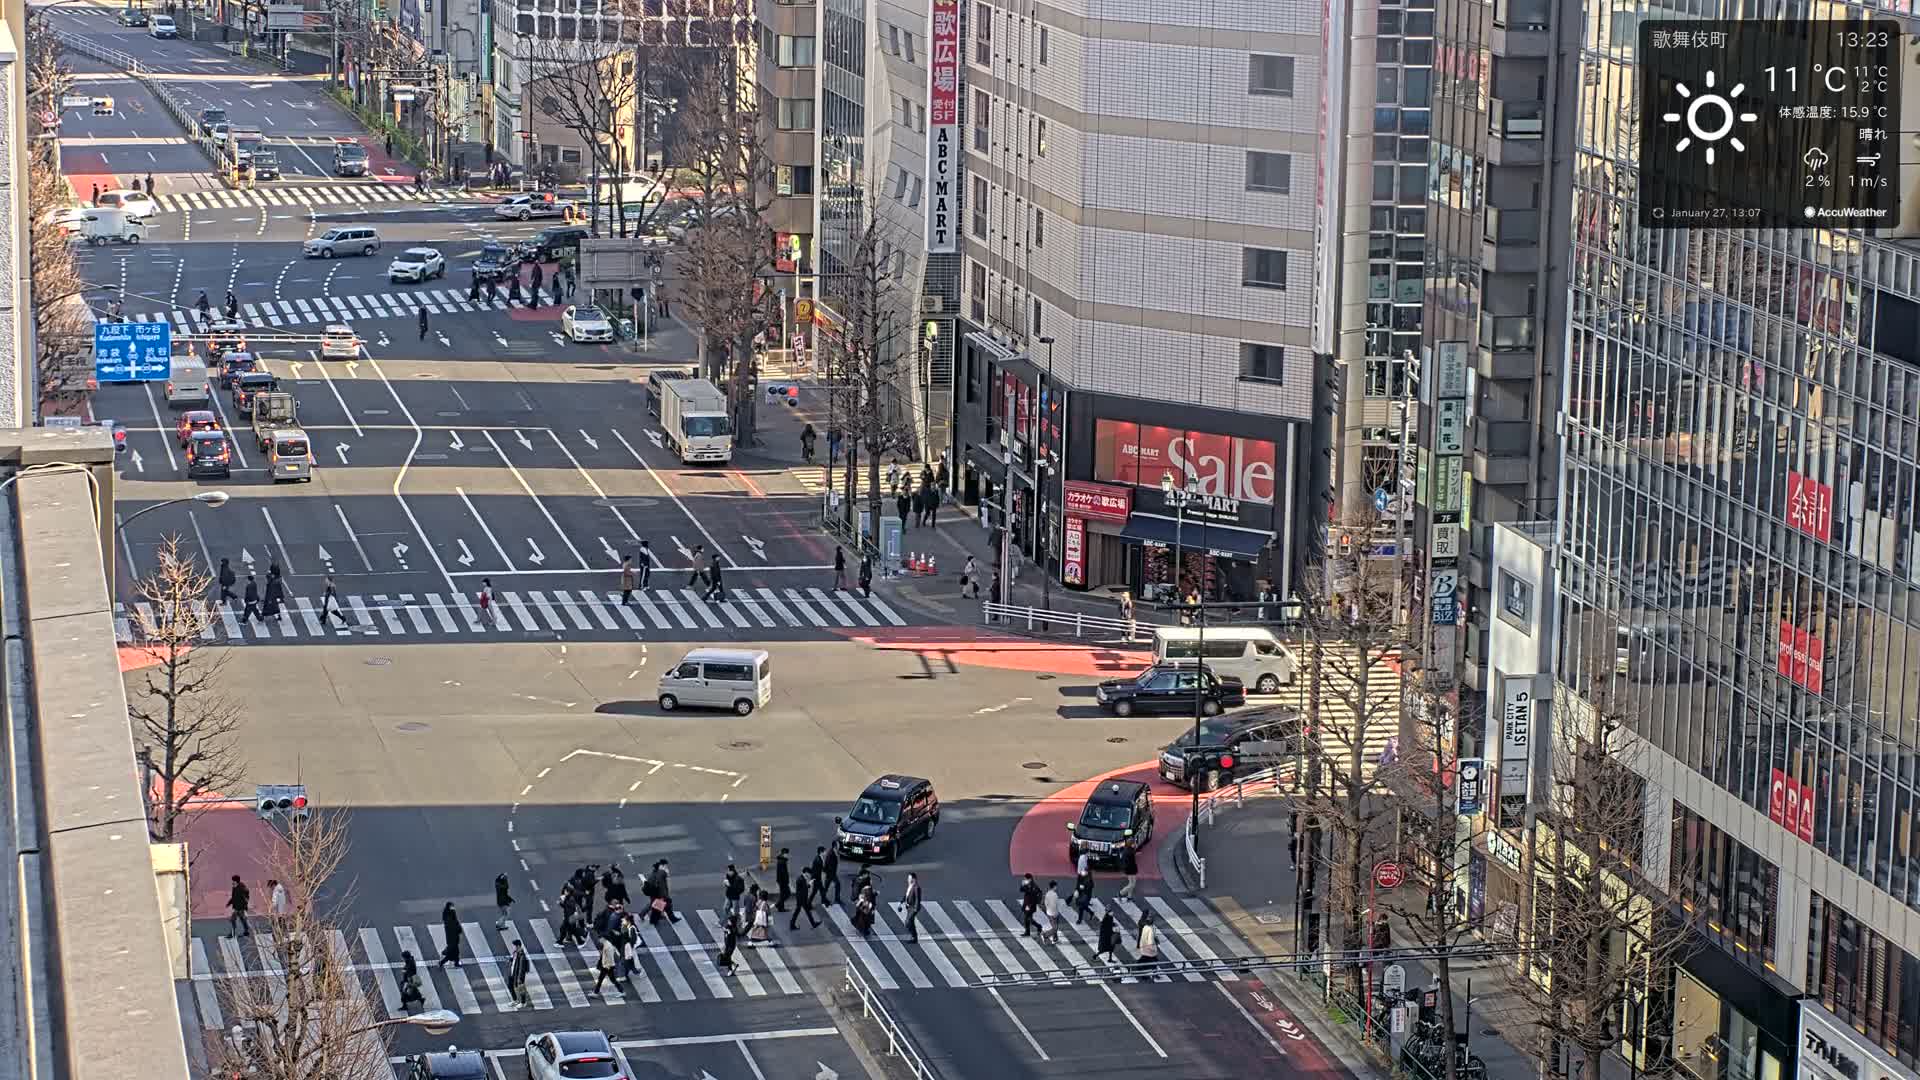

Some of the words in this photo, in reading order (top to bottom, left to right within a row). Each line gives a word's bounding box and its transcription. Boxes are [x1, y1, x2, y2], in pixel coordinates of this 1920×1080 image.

[934, 11, 956, 92] 歌広場
[933, 99, 955, 109] 受付
[934, 111, 954, 121] 5F
[101, 326, 129, 335] 九段下
[1122, 443, 1160, 457] ABCMART
[1168, 436, 1274, 503] Sale
[1068, 492, 1093, 504] カラオケ
[1792, 481, 1828, 532] 会計
[1437, 527, 1449, 554] 買取
[1780, 640, 1822, 673] professional
[1516, 692, 1528, 701] 5
[1506, 703, 1515, 720] CITY
[1506, 721, 1514, 740] PARK
[1514, 706, 1527, 747] ISETAN
[1773, 781, 1811, 830] CPA
